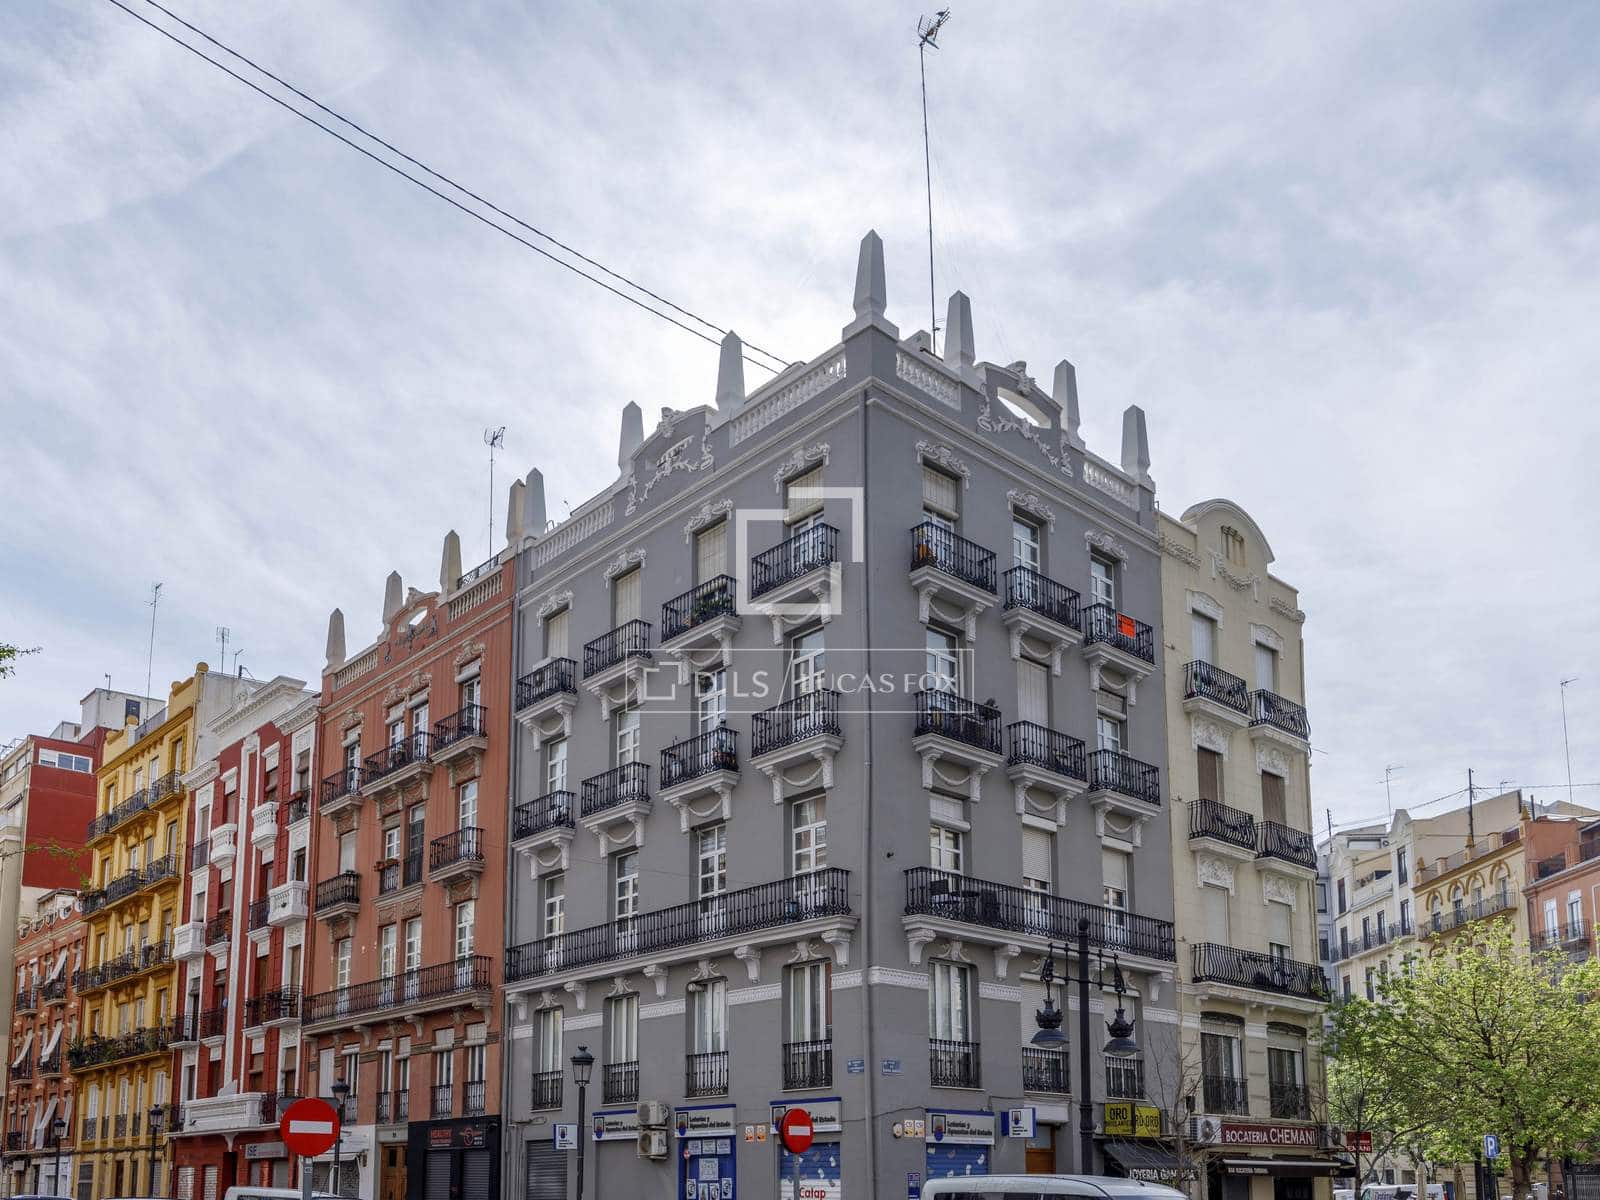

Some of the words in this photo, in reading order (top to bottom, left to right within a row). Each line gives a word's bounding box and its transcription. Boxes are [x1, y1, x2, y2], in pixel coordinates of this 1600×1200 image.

[1109, 1107, 1128, 1120] ORO
[1225, 1129, 1268, 1143] BOCATERIA
[1269, 1128, 1316, 1145] CHEMANI
[1488, 1139, 1495, 1155] P
